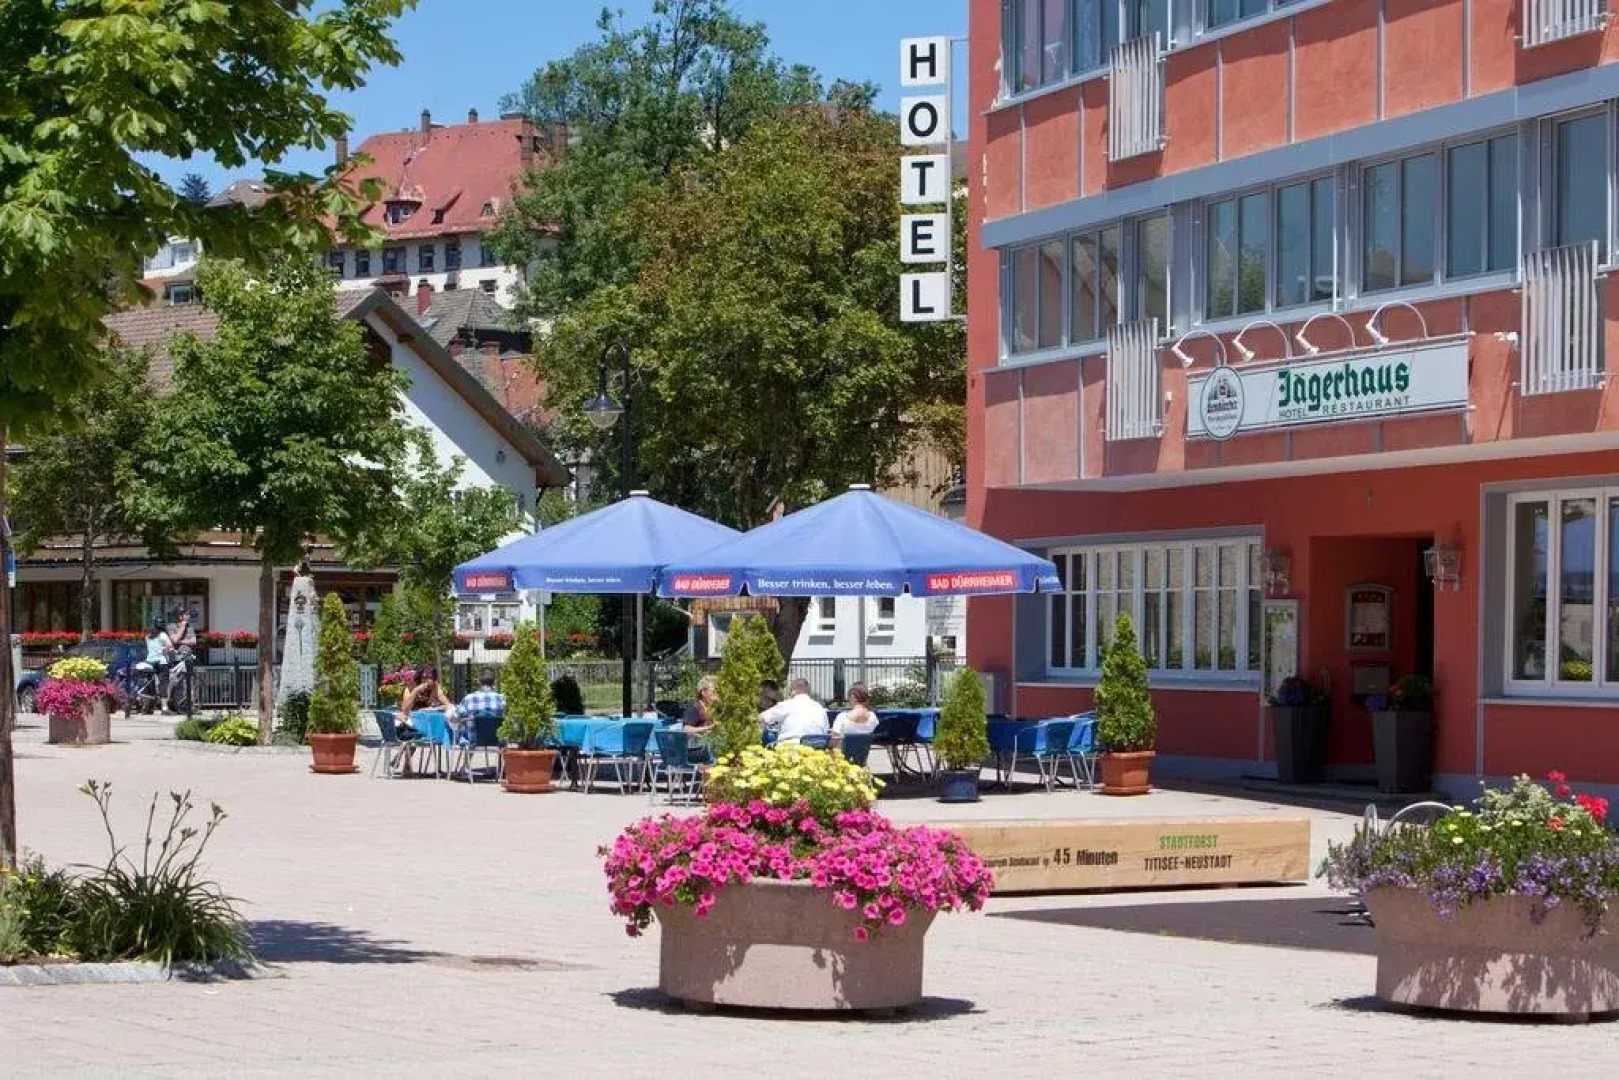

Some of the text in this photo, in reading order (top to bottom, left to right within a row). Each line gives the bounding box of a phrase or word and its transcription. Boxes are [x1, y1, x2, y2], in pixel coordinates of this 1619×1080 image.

[908, 43, 938, 314] HOTEL
[1278, 362, 1410, 412] Jägerhaus
[1279, 395, 1410, 418] HOTEL RESTAURANT
[758, 578, 789, 588] Besser
[792, 579, 831, 590] trinken,
[833, 579, 863, 589] besser
[930, 574, 1013, 589] BAD DÜRRHEIMER
[1160, 834, 1218, 849] STADTFORST
[1053, 848, 1071, 865] 45
[1076, 849, 1118, 865] Minuten
[1144, 855, 1232, 871] TITISEE-NEUSTADT
